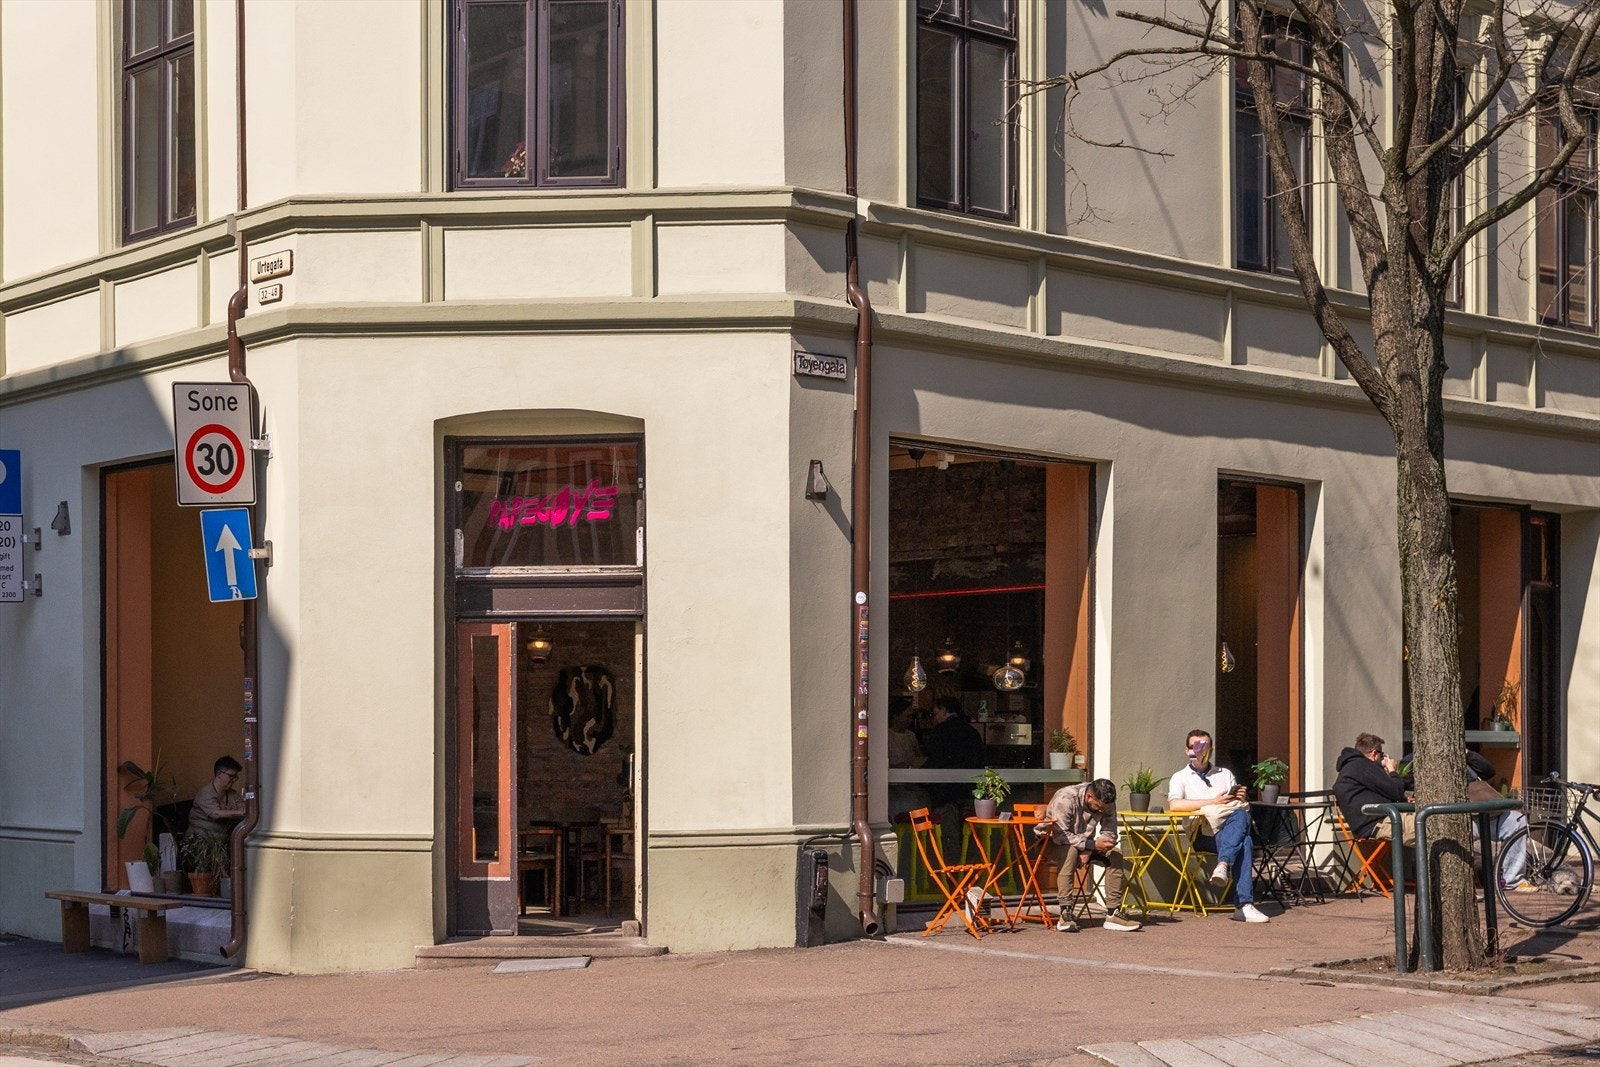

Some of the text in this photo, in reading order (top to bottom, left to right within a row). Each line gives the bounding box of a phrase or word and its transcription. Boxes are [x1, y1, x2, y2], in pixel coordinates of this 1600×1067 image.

[257, 257, 283, 275] Urtegata
[187, 390, 238, 412] Sone
[196, 442, 235, 476] 30
